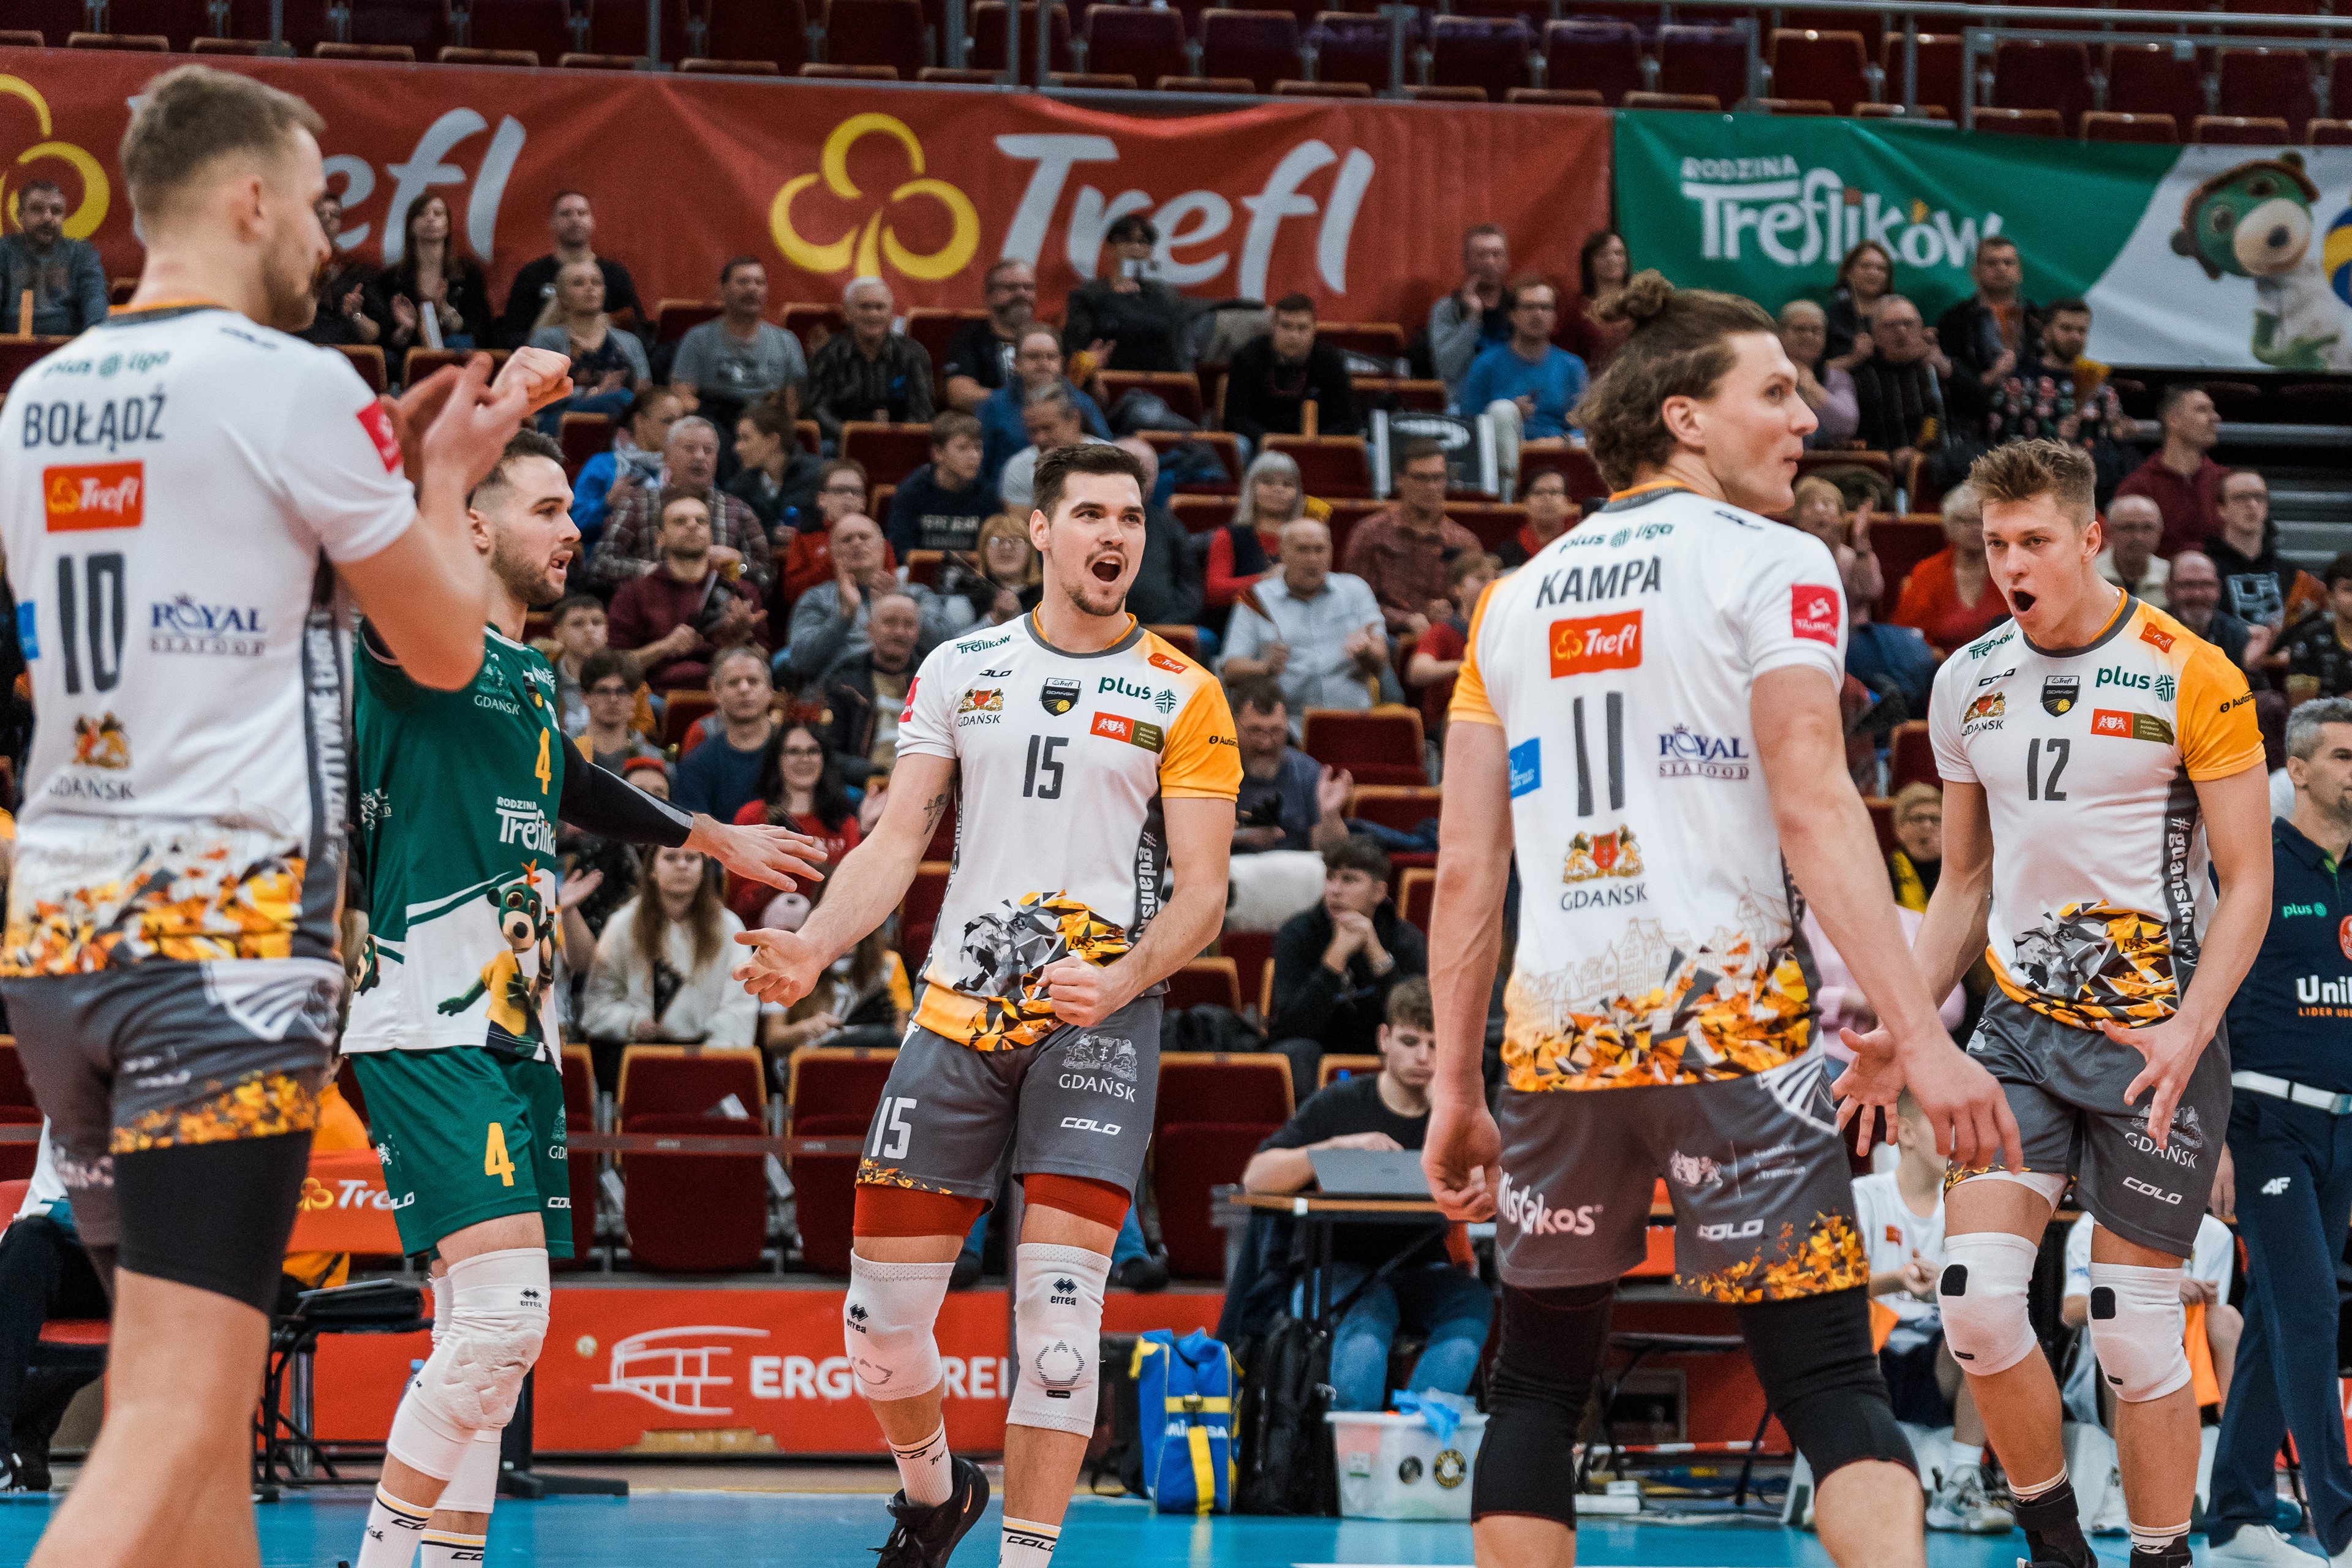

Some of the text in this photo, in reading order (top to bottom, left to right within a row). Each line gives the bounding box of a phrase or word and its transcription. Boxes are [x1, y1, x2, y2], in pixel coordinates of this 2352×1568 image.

[1682, 156, 1800, 179] RODZINA
[995, 132, 1376, 300] Trefl
[23, 383, 166, 451] BOŁĄDŹ
[80, 475, 139, 513] Trefl
[1559, 522, 1675, 554] plus liga
[1536, 555, 1662, 609] KAMPA
[58, 551, 126, 695] 10
[152, 601, 268, 638] ROYAL
[1585, 624, 1637, 657] Trefl
[978, 669, 1012, 677] OLO
[1163, 658, 1184, 671] Trefl
[1978, 668, 2016, 687] COO
[2095, 666, 2150, 690] plus
[1098, 677, 1152, 700] plus
[473, 695, 520, 715] GDAŃSK
[958, 713, 1001, 727] GDAŃSK
[1219, 736, 1238, 748] Autom
[1573, 691, 1626, 818] 11
[1658, 733, 1749, 763] ROYAL
[535, 727, 551, 795] 4
[1023, 734, 1069, 799] 15
[2027, 738, 2070, 801] 12
[496, 796, 537, 810] RODZINA
[496, 807, 556, 858] Treflik
[1135, 832, 1161, 938] #gdański
[1562, 883, 1648, 911] GDAŃSK
[2283, 903, 2313, 919] plus
[2298, 1006, 2332, 1017] LIDER
[1059, 1074, 1135, 1103] GDAŃSK
[870, 1096, 918, 1159] 15
[1060, 1117, 1121, 1136] COLO
[484, 1121, 514, 1186] 4
[548, 1145, 568, 1159] GDA
[2125, 1132, 2199, 1169] GDAŃSK
[338, 1179, 392, 1210] Tre
[2122, 1176, 2183, 1205] COLO
[2261, 1176, 2291, 1195] 4F
[548, 1196, 571, 1208] COL
[1697, 1218, 1764, 1240] COLO
[1050, 1295, 1076, 1306] errea
[846, 1318, 867, 1334] errea
[750, 1355, 865, 1400] ERG
